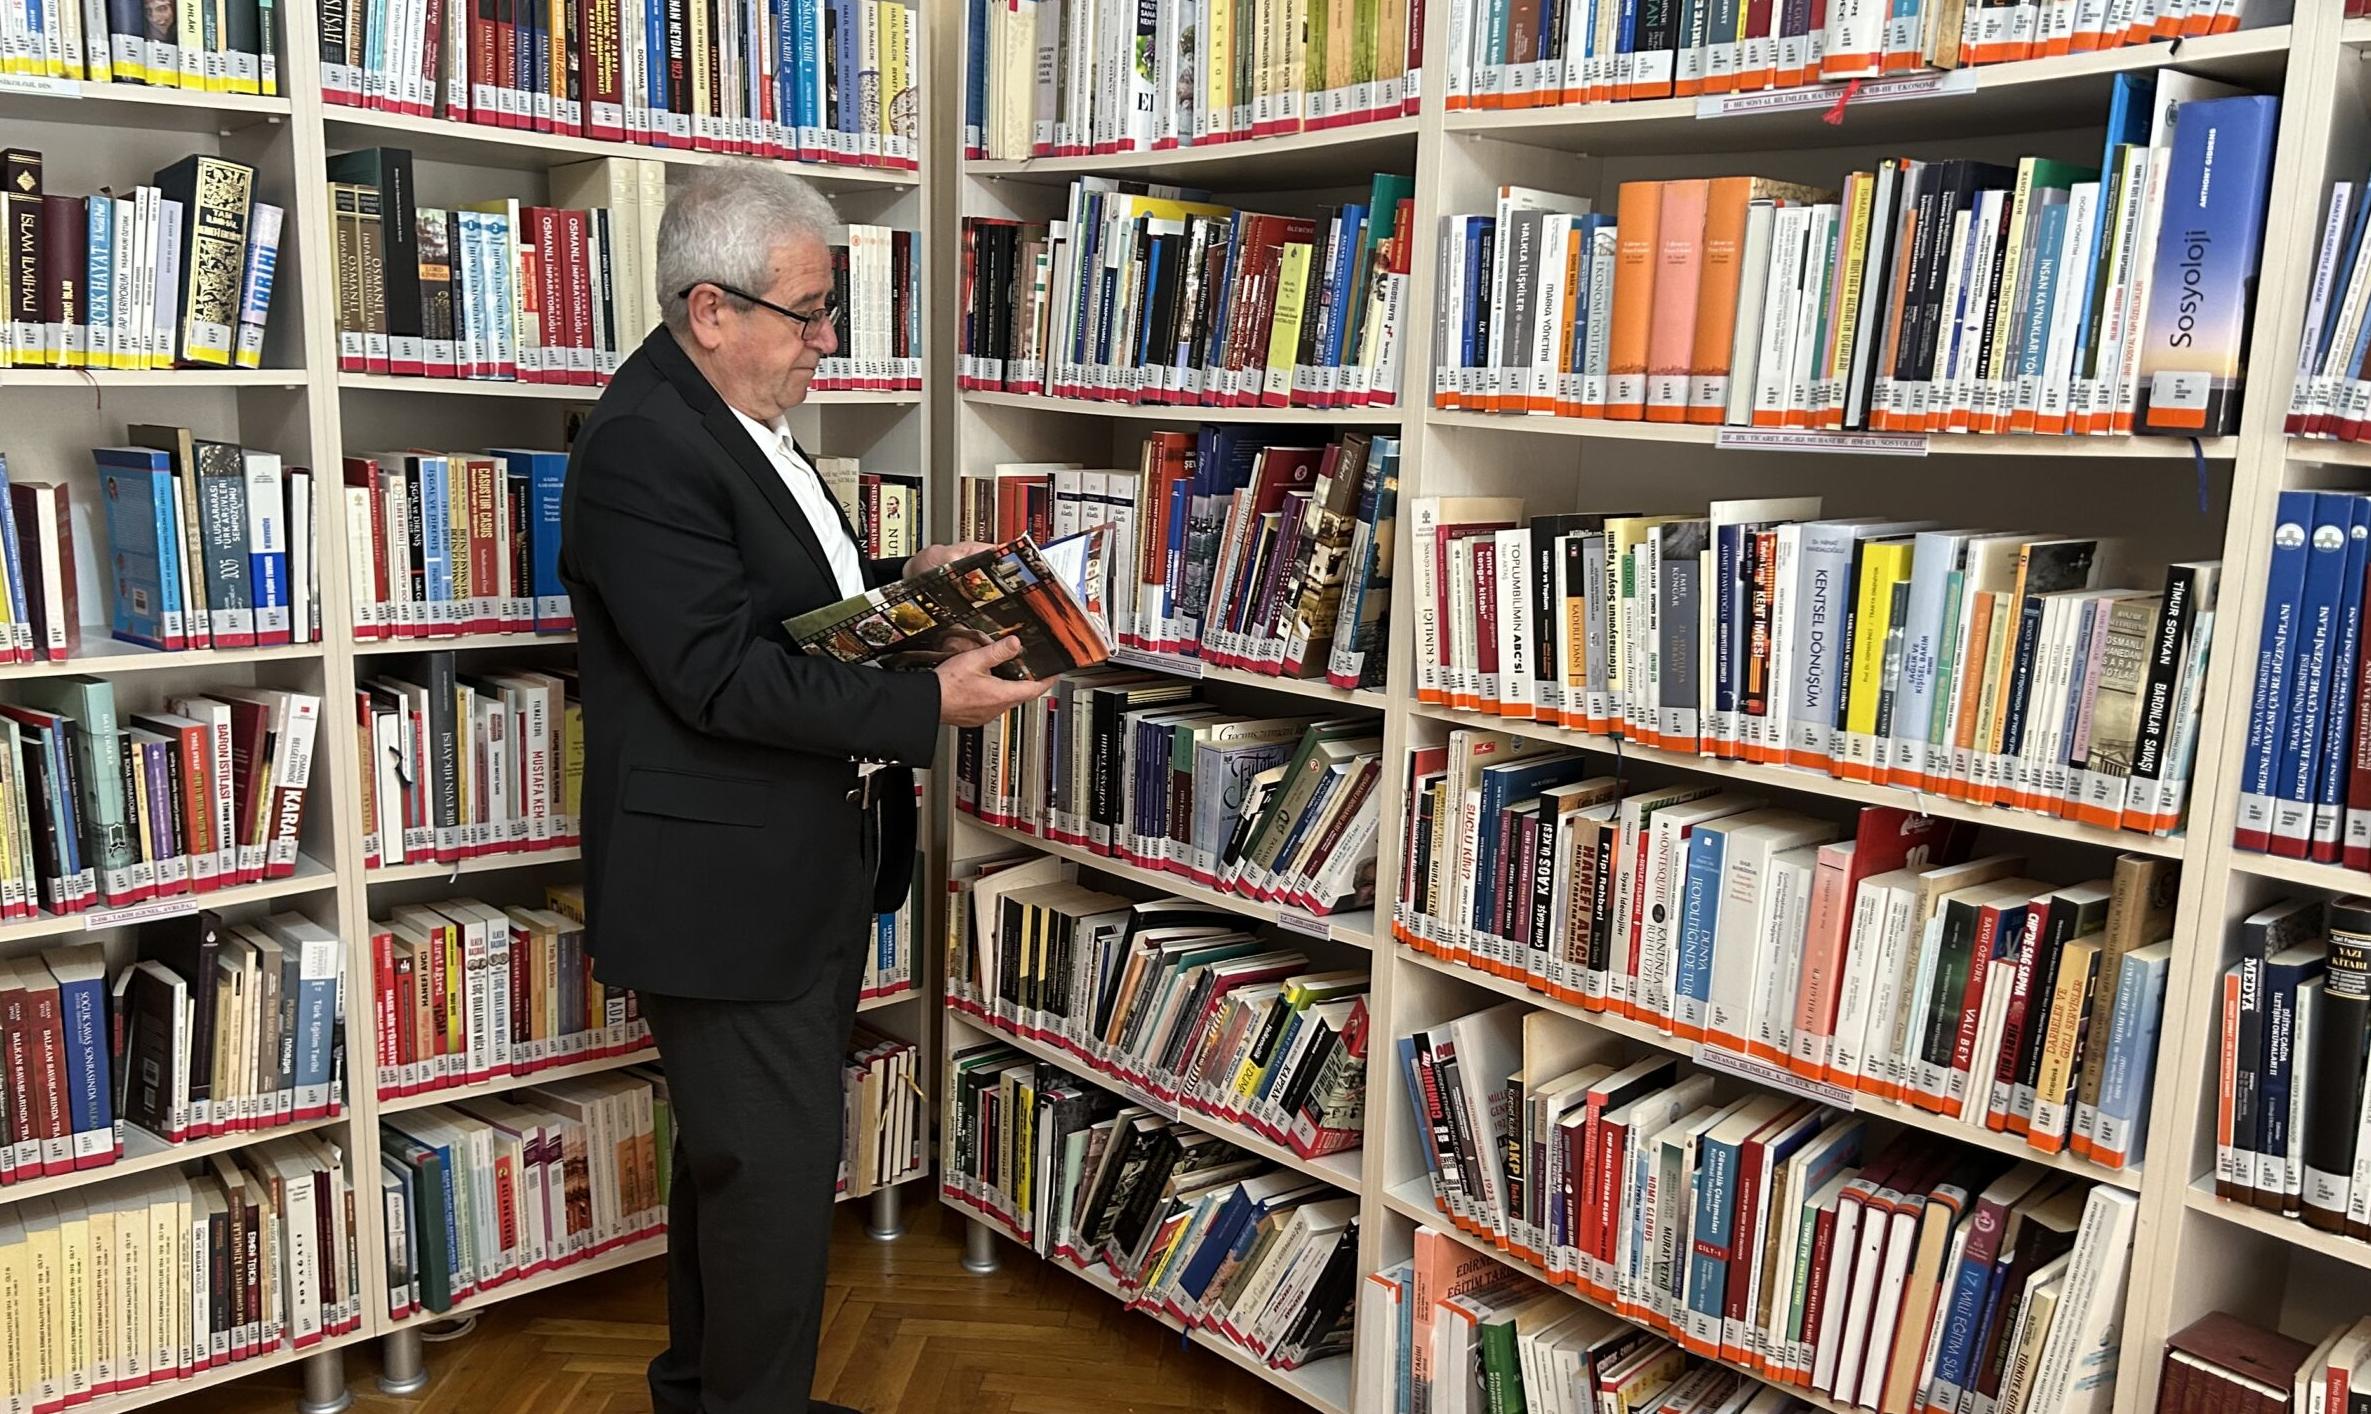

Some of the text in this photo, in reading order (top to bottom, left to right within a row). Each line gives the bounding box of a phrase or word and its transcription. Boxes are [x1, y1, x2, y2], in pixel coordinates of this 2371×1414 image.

[637, 49, 646, 90] DONANMA
[670, 21, 683, 80] MEYDAN 1923
[2016, 170, 2028, 215] BOB LOSYK
[2198, 127, 2217, 209] ANTHONY GIDDENS
[542, 216, 553, 262] OSMANLI
[569, 217, 580, 263] OSMANLI
[2072, 223, 2083, 256] YÖNETİM
[347, 255, 360, 312] OSMANLI
[372, 257, 385, 314] OSMANLI
[1515, 223, 1530, 312] HALKLA İLİŞKİLER
[1592, 261, 1604, 316] EKONOMİ
[2170, 228, 2211, 348] Sosyoloji
[1543, 284, 1554, 316] MARKA
[209, 484, 222, 545] ULUSLARARASI
[217, 479, 232, 550] TÜRK ARŞİVLERİ
[229, 487, 242, 542] SEMPOZYUMU
[410, 481, 422, 547] İŞGAL ve DİRENİŞ
[426, 469, 439, 551] İŞGAL VE DİRENİŞ
[478, 467, 493, 538] CASUSTUR CASUS
[871, 513, 878, 523] 29
[1164, 549, 1173, 592] UZUNKÖPRÜ
[1541, 549, 1550, 611] Kültür ve Toplum
[1671, 566, 1680, 608] KONGAR
[1679, 573, 1688, 598] EMRE
[1423, 607, 1434, 656] KİMLİĞİ
[1511, 543, 1525, 674] TOPLUMBİLİMİN ABC'Sİ
[1605, 530, 1618, 680] Enformasyonun Sosyal Yaşamı
[2159, 580, 2185, 665] TİMUR SOYKAN
[1571, 603, 1581, 668] KADERLE DANS
[1805, 569, 1828, 709] KENTSEL DÖNÜŞÜM
[2106, 634, 2144, 651] OSMANLI
[533, 700, 545, 720] YILMAZ
[2250, 650, 2272, 747] TRAKYA ÜNİVERSİTESİ
[2290, 653, 2311, 752] TRAKYA ÜNİVERSİTESİ
[2139, 682, 2167, 773] BARONLAR SAVAŞI
[286, 737, 300, 784] BELGELERİNDE
[296, 754, 308, 784] OSMANLI
[531, 750, 545, 796] MUSTAFA
[1098, 733, 1109, 816] GAZİPAŞA TARİHİ
[1461, 847, 1475, 881] KİM?
[1536, 822, 1553, 896] KAOS ÜLKESİ
[1654, 830, 1669, 903] MONTESQUIEU
[1617, 871, 1629, 937] Siyasi İdeolojiler
[1534, 924, 1544, 949] Çetin
[1575, 918, 1592, 966] AVCI
[1644, 923, 1655, 955] RUHU
[2338, 946, 2363, 959] YAZI
[419, 951, 429, 1007] HANEFİ AVCI
[432, 937, 445, 997] Murat Ağırel
[1957, 916, 1993, 1063] SAYGI ÖZTÜRK VALİ BEY
[2240, 956, 2257, 1012] MEDYA
[42, 1029, 52, 1062] BALKAN
[80, 991, 97, 1101] SOĞUK SAVAŞ SONRASINDA
[309, 999, 323, 1073] Türk Eğitim Tarihi
[2045, 987, 2068, 1056] DARBELER VE
[2059, 979, 2083, 1060] GİZLİ SERVİSLER
[12, 1031, 22, 1065] BALKAN
[16, 1065, 28, 1124] SAVAŞLARINDA
[46, 1063, 59, 1121] SAVAŞLARINDA
[1272, 1063, 1292, 1104] KAPTAN
[1506, 1087, 1516, 1138] Küresel Kukla
[1507, 1139, 1521, 1175] AKP
[1644, 1175, 1657, 1243] HOMO GLOBUS
[1710, 1150, 1727, 1235] Güvenlik Çalışmaları
[231, 1221, 243, 1265] AZINLIKLAR
[1660, 1226, 1672, 1260] MURAT
[1446, 1278, 1483, 1299] EĞİTİM
[1964, 1269, 1978, 1288] 17
[1948, 1316, 1968, 1355] EĞİTİM
[2012, 1352, 2029, 1388] TÜRKİYE
